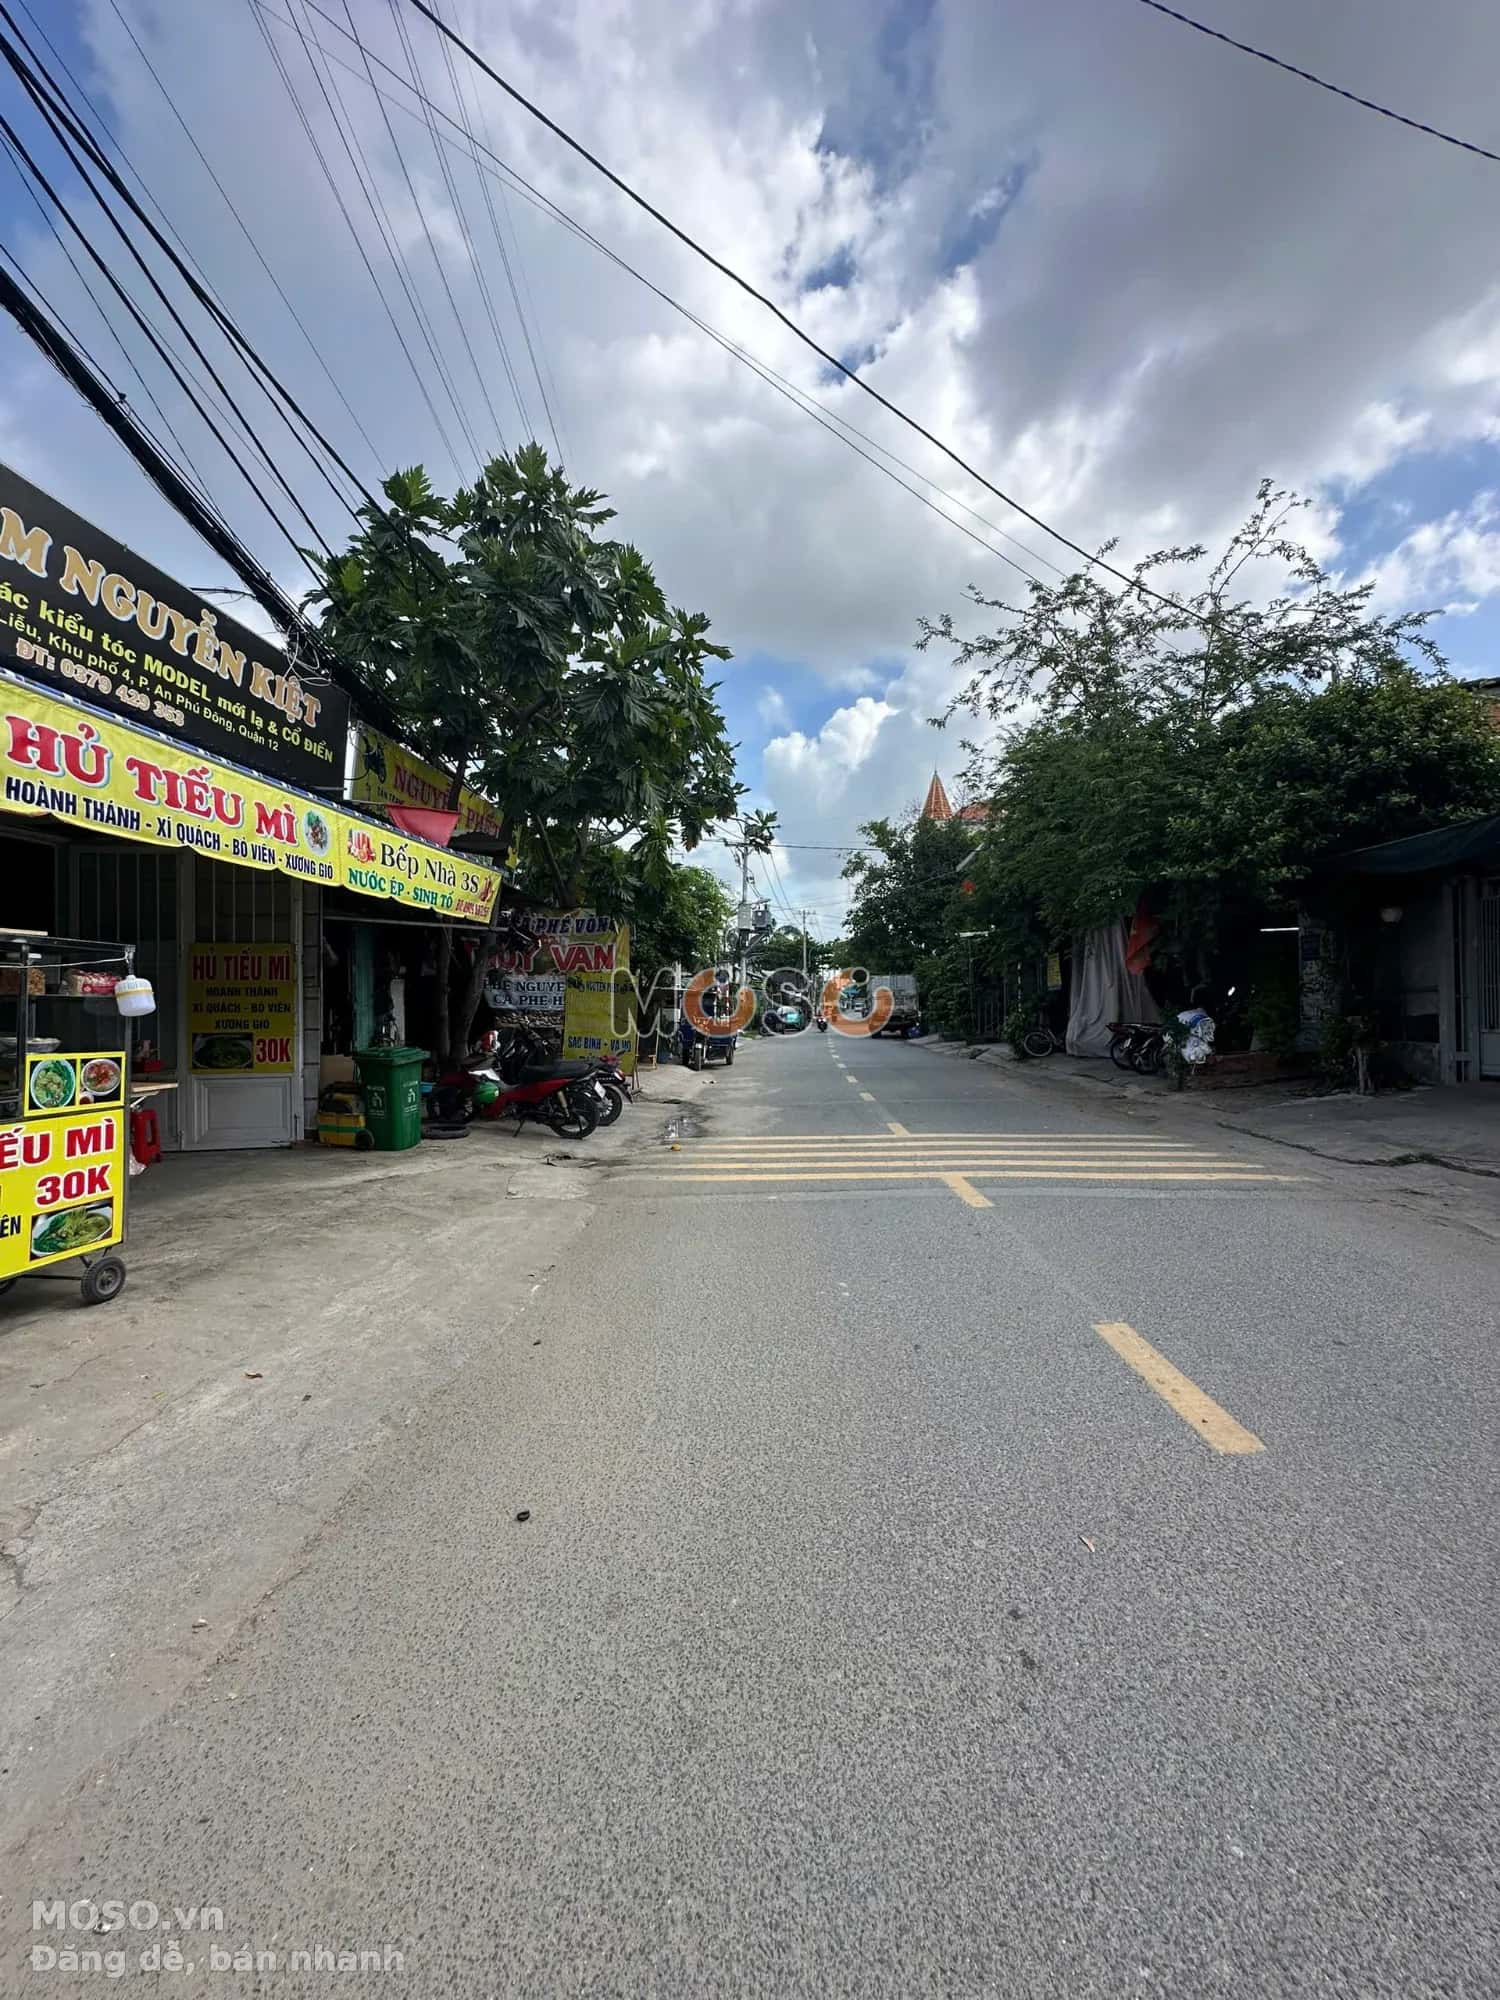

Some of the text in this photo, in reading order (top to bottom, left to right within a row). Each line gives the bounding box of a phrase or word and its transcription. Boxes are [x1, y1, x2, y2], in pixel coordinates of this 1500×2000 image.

[39, 599, 94, 643] kiểu
[101, 632, 137, 663] tóc
[144, 653, 212, 702] MODEL
[217, 695, 247, 720] mới
[251, 709, 264, 731] lạ
[268, 721, 279, 736] &
[282, 727, 302, 746] CỔ
[303, 737, 333, 763] ĐIỂN
[48, 631, 83, 659] Khu
[87, 650, 120, 676] phố
[139, 676, 151, 692] P.
[153, 684, 173, 702] An
[175, 692, 200, 714] Phú
[238, 725, 265, 746] Quận
[268, 738, 280, 752] 12
[60, 657, 112, 694] 0379
[249, 661, 321, 728] KIỆT
[5, 715, 299, 846] HỦ TIẾU MÌ
[5, 776, 77, 816] HOÀNH
[82, 792, 141, 832] THÁNH
[156, 815, 173, 840] XÍ
[176, 821, 221, 852] QUÁCH
[232, 836, 249, 859] BÒ
[250, 840, 276, 866] VIÊN
[284, 853, 317, 877] XƯƠNG
[348, 866, 387, 893] NƯỚC
[389, 876, 405, 896] ÉP
[412, 886, 438, 905] SINH
[440, 890, 455, 909] TỐ
[380, 843, 479, 894] Bếp Nhà 3S
[192, 946, 217, 981] HỦ
[223, 947, 262, 981] TIẾU
[256, 1037, 291, 1063] 30K
[66, 1118, 115, 1157] MÌ
[36, 1164, 111, 1205] 30K
